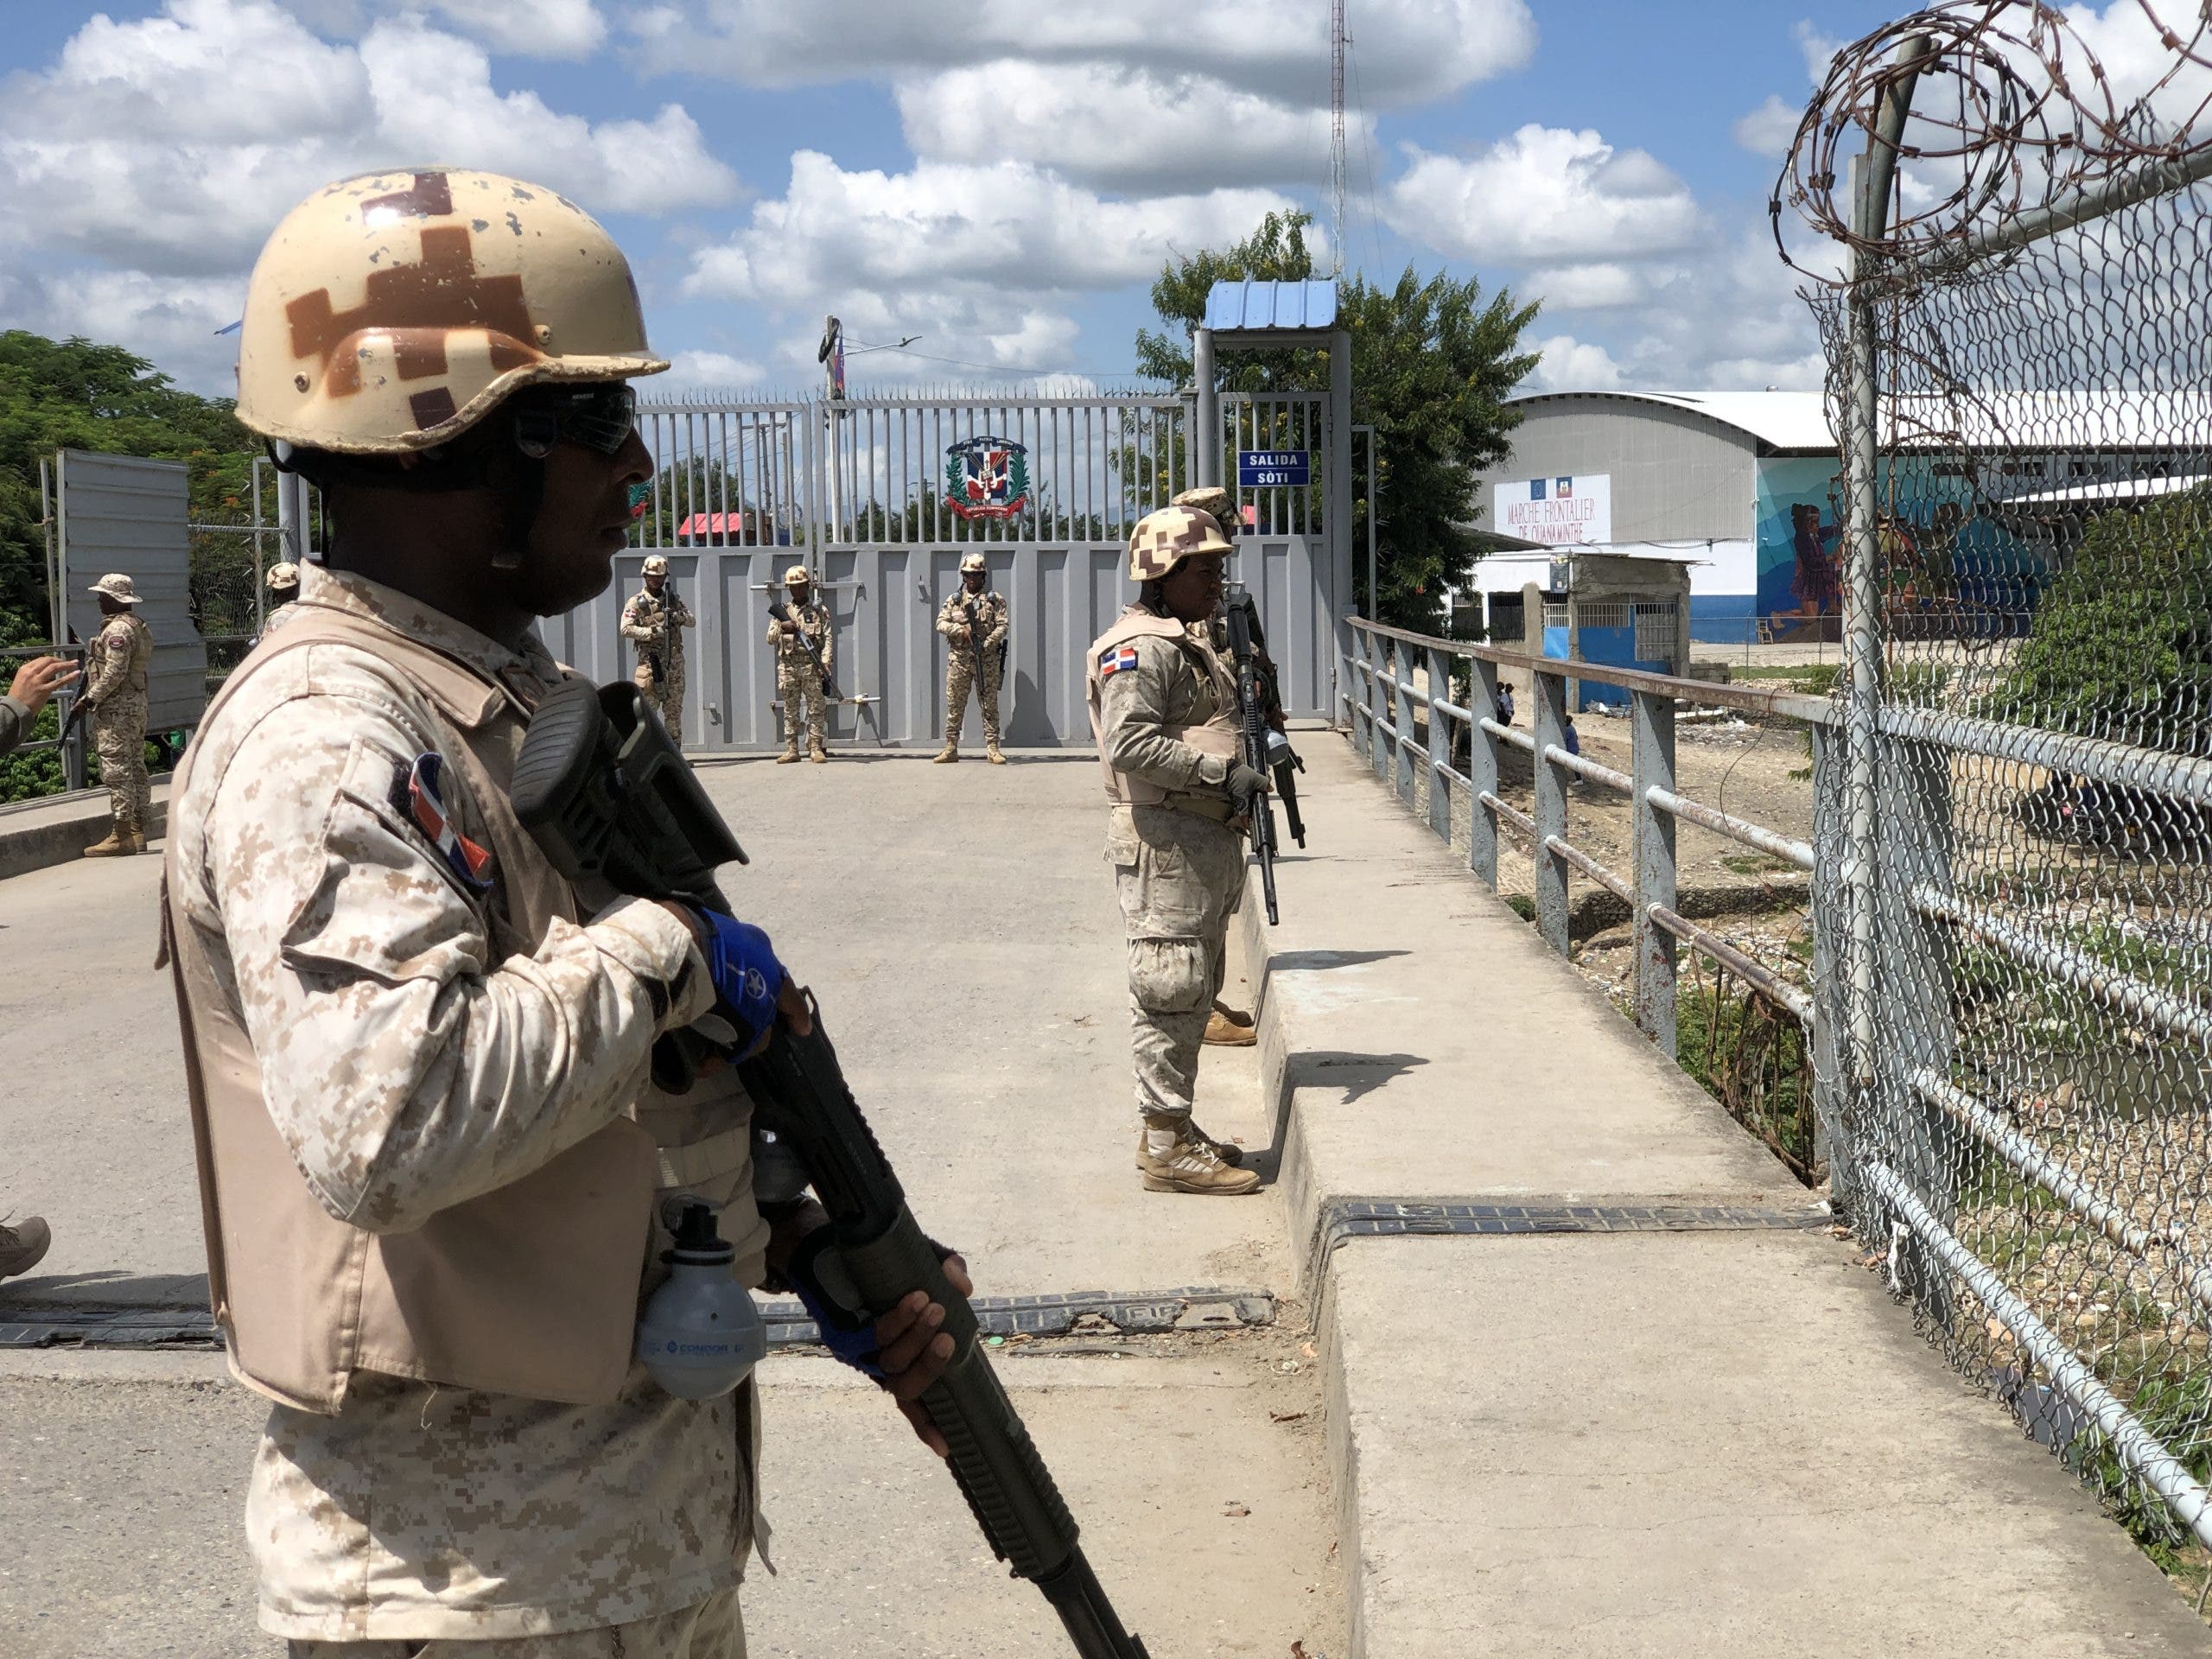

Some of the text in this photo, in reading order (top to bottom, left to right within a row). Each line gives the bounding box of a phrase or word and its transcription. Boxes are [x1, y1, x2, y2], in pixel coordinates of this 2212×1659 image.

[1249, 454, 1298, 466] SALIDA
[1257, 470, 1288, 484] SÒTI
[1508, 499, 1596, 524] MARCHE FRONTALIER
[1519, 525, 1528, 539] DE
[679, 1344, 728, 1353] CONDOR
